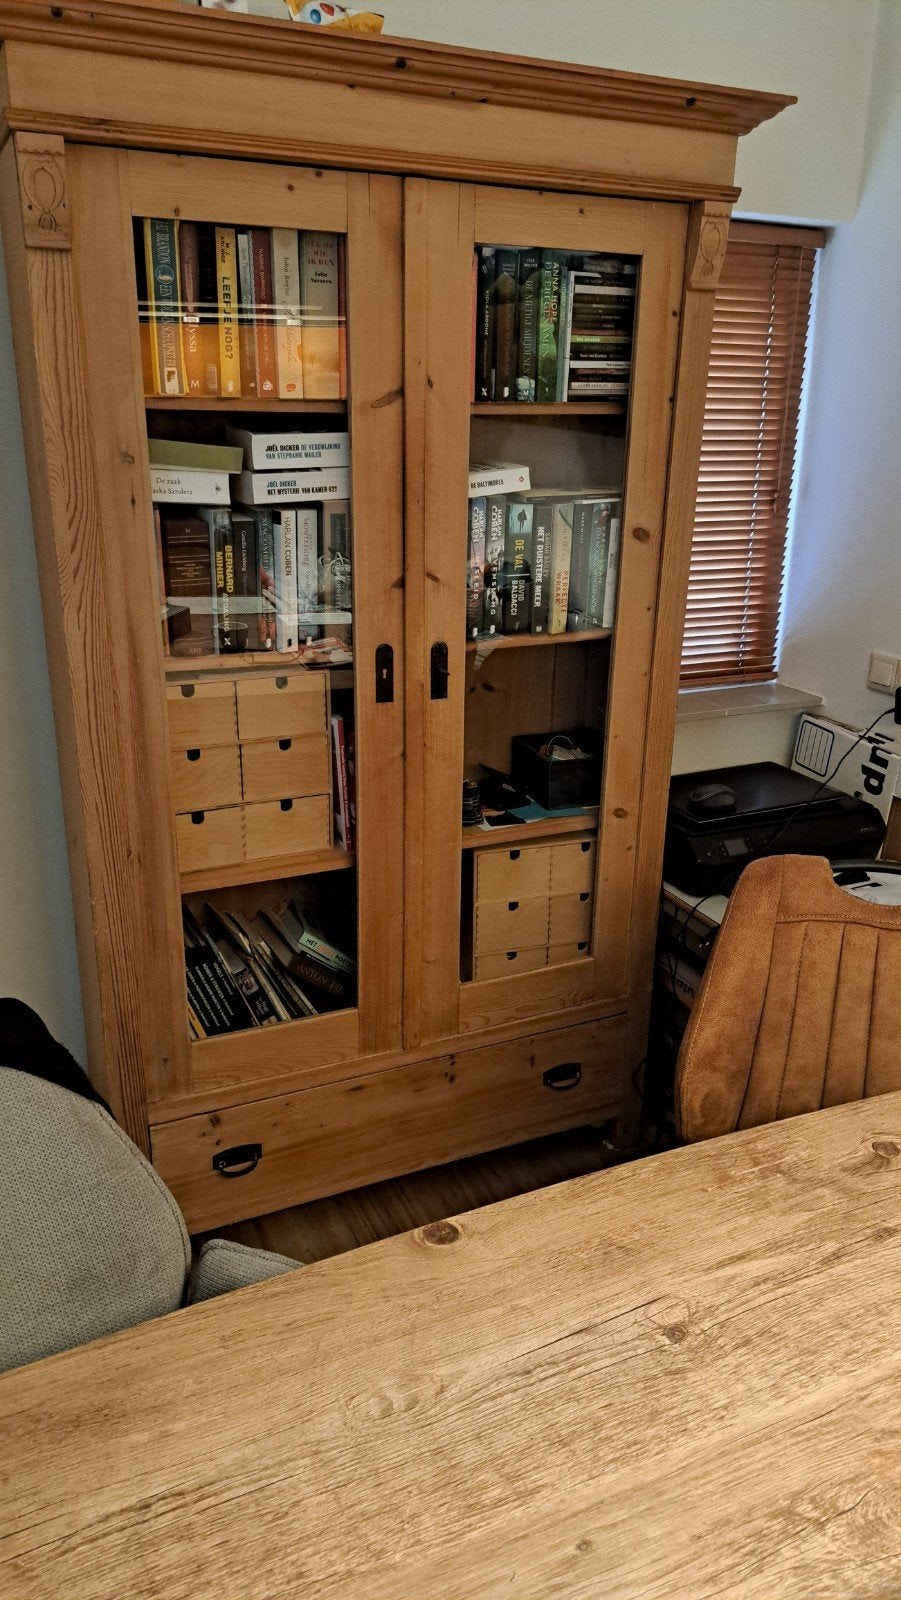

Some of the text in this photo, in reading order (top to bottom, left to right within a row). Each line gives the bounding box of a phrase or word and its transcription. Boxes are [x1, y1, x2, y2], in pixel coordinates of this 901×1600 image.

[156, 232, 171, 265] BRANDON
[544, 260, 552, 276] DE
[552, 262, 560, 292] ANNA
[222, 276, 232, 307] LEEF
[224, 326, 234, 360] NOG?
[522, 328, 532, 374] MILJOENEN
[216, 551, 224, 588] MINIER
[224, 544, 234, 592] BERNARD
[514, 539, 524, 570] DE VAL
[535, 544, 543, 582] DUISTERE
[534, 585, 542, 607] MEER
